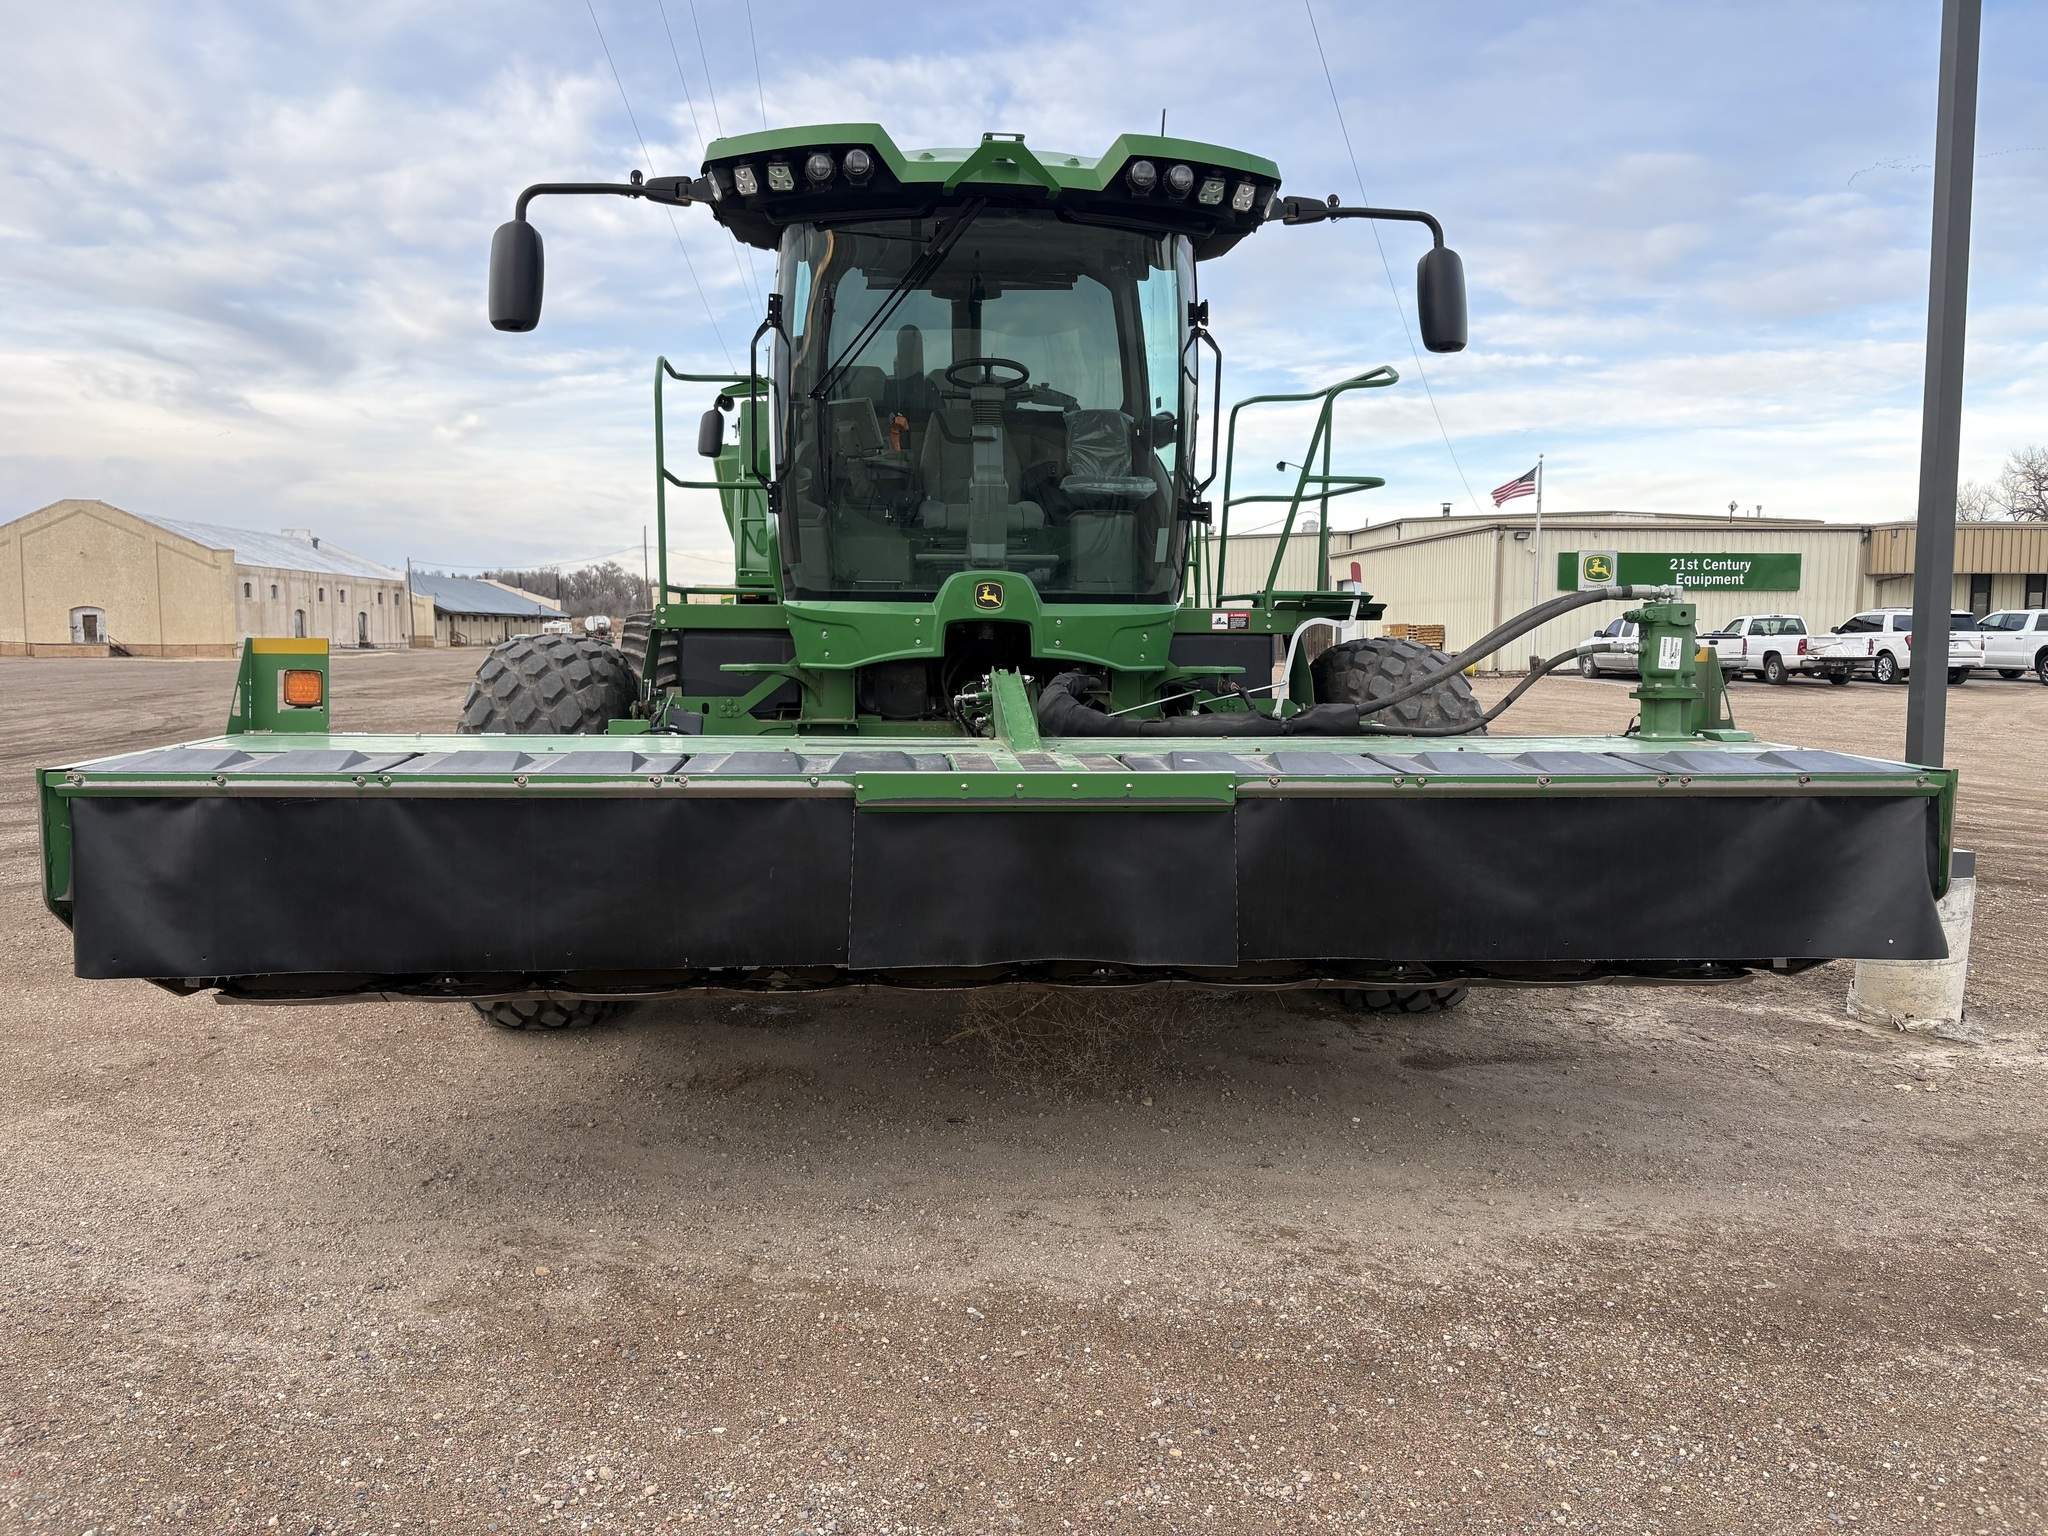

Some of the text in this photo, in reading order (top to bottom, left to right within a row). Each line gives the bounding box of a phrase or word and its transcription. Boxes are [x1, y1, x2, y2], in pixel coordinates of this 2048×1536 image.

[1669, 558, 1752, 573] 21st Century
[1675, 573, 1745, 588] Equipment
